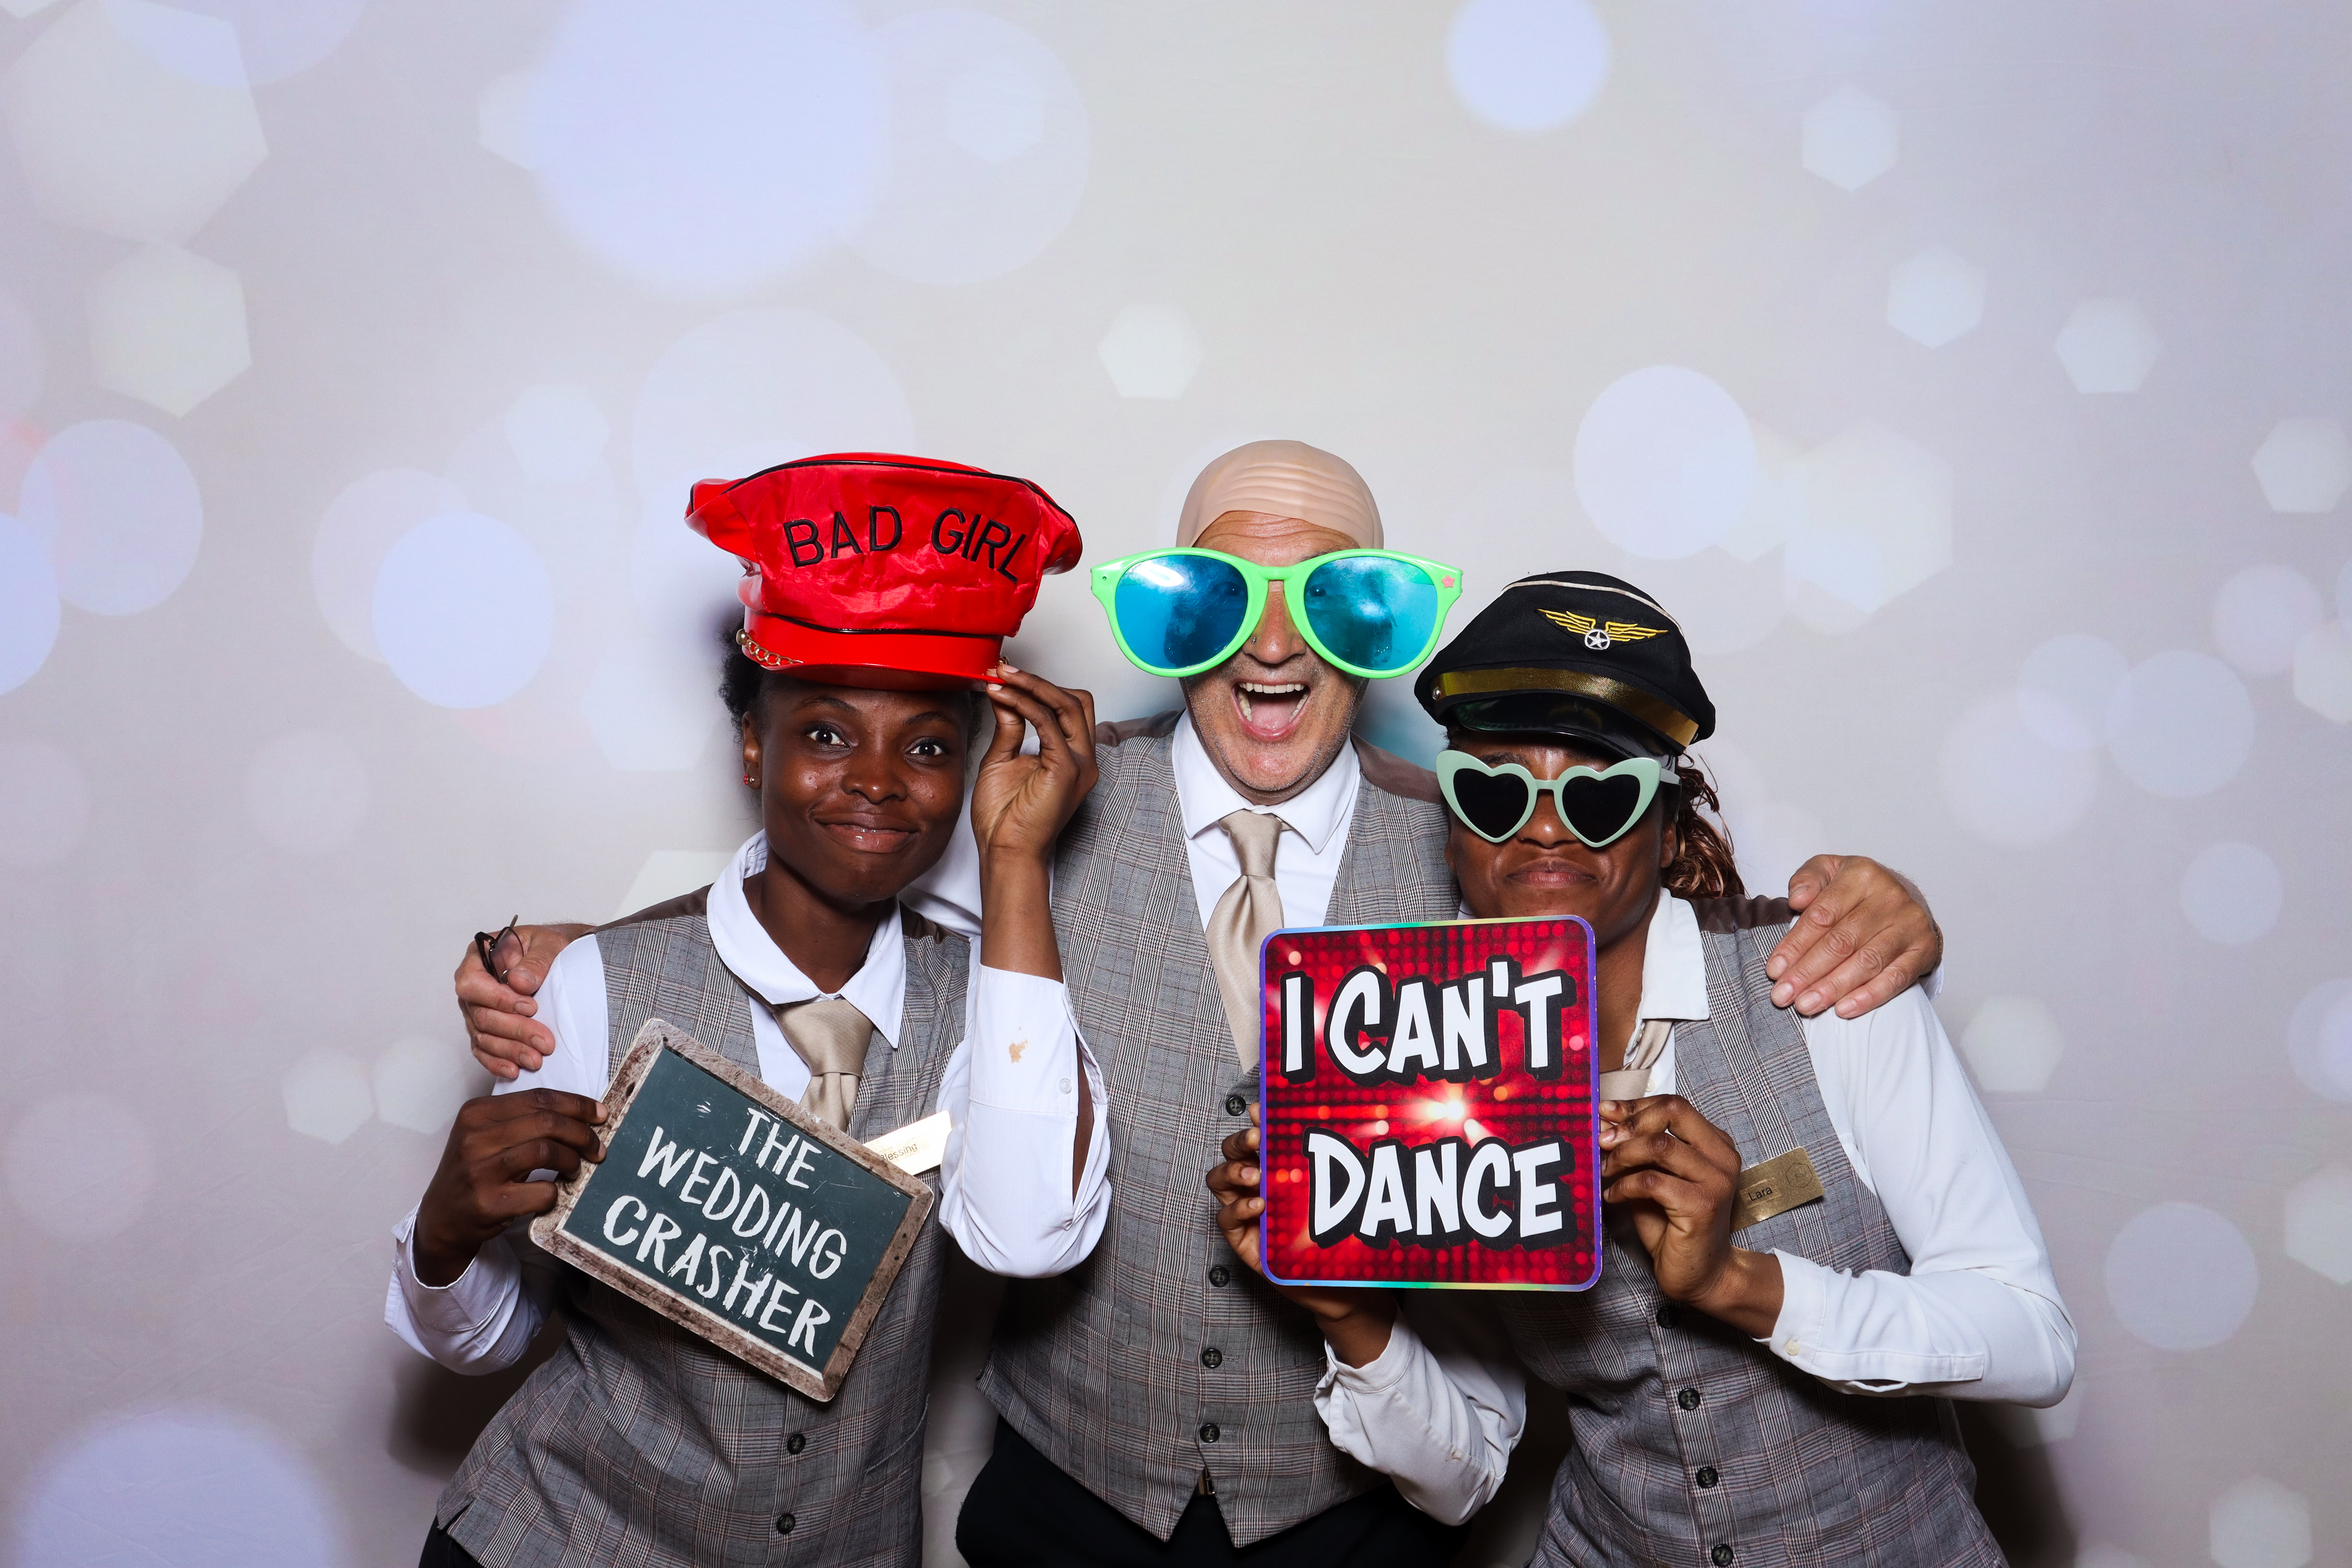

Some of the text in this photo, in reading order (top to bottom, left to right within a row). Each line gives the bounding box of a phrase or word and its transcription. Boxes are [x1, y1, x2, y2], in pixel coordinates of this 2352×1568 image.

[784, 505, 1027, 584] BAD GIRL
[1285, 961, 1563, 1075] I CAN'T
[738, 1107, 822, 1189] THE
[1307, 1132, 1563, 1238] DANCE
[1748, 1186, 1773, 1201] Lara
[637, 1125, 847, 1280] WEDDING
[603, 1195, 831, 1357] CRASHER
